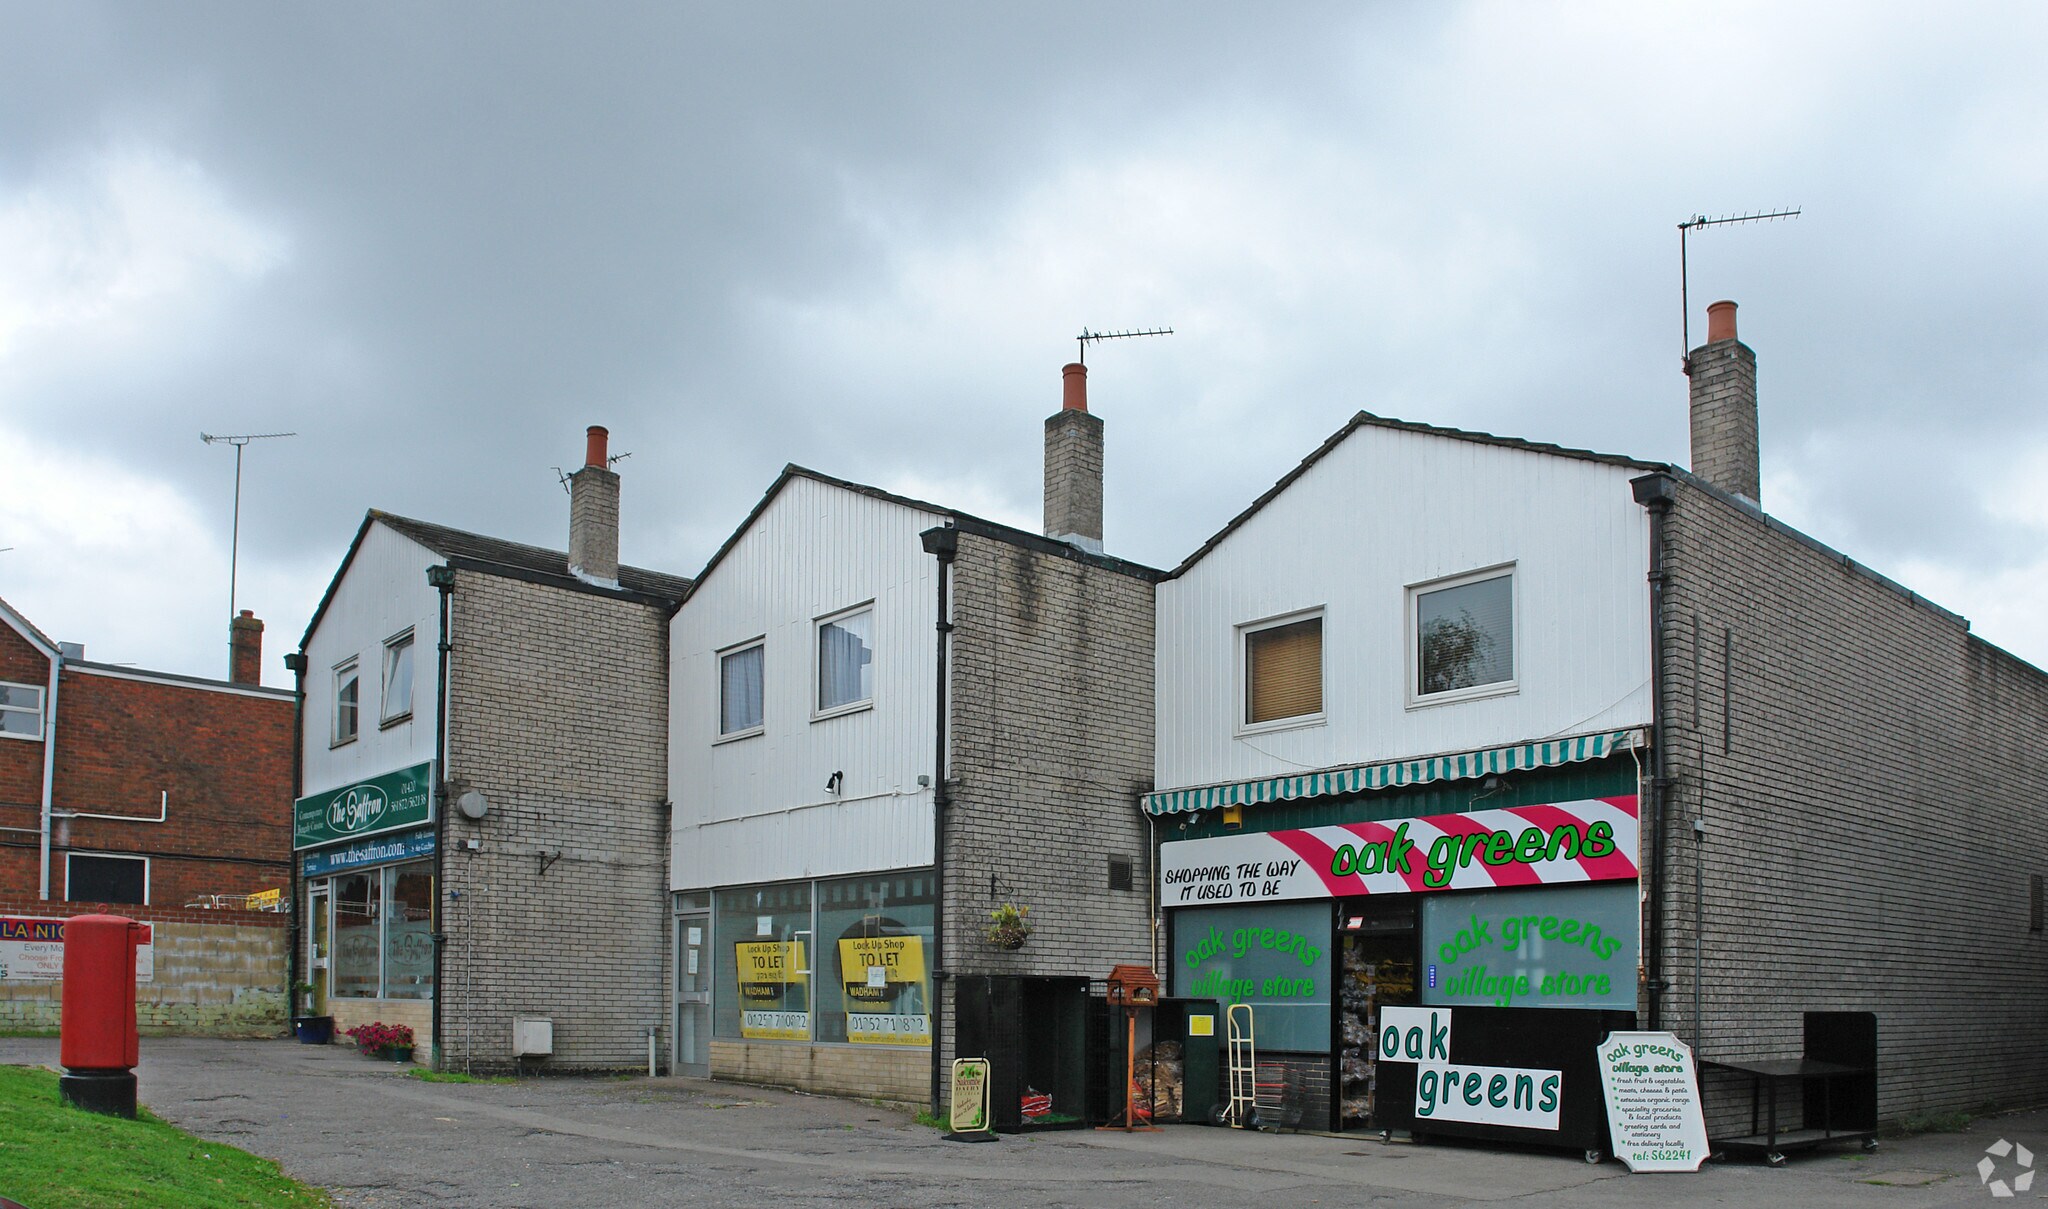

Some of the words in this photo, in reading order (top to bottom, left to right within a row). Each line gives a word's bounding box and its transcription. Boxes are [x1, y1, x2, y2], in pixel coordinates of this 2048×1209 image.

[332, 801, 345, 824] The
[346, 790, 382, 830] Saffron
[1330, 821, 1415, 877] oak
[1423, 820, 1616, 888] greens
[1165, 865, 1231, 885] SHOPPING
[1237, 862, 1263, 879] THE
[1267, 859, 1301, 877] WAY
[1180, 885, 1195, 901] IT
[1197, 883, 1233, 900] USED
[1239, 881, 1258, 898] TO
[1261, 880, 1281, 896] BE
[1438, 914, 1493, 964] oak
[1502, 915, 1622, 960] greens
[24, 944, 48, 952] Every
[762, 945, 772, 954] Up
[853, 941, 869, 950] Lock
[871, 941, 882, 951] Up
[884, 940, 905, 950] Shop
[1185, 926, 1227, 969] oak
[1232, 927, 1322, 967] greens
[37, 961, 59, 970] ONLY
[752, 956, 766, 969] TO
[768, 956, 785, 969] LET
[859, 953, 875, 967] TO
[880, 952, 899, 967] LET
[745, 986, 771, 996] WADHAM
[850, 987, 880, 997] WADHAM
[1191, 969, 1255, 1005] village
[1262, 975, 1315, 997] store
[1445, 965, 1530, 1007] village
[1540, 970, 1611, 995] store
[1382, 1011, 1448, 1060] oak
[1607, 1043, 1631, 1062] oak
[1633, 1044, 1684, 1062] greens
[1612, 1061, 1650, 1077] village
[1654, 1064, 1684, 1073] store
[1655, 1077, 1685, 1086] vegetables
[1418, 1070, 1559, 1116] greens
[1647, 1096, 1671, 1105] organic
[1672, 1097, 1690, 1105] range
[1621, 1105, 1650, 1114] speciality
[1652, 1106, 1682, 1115] groceries
[1653, 1114, 1682, 1122] products
[1624, 1123, 1648, 1131] greeting
[1631, 1131, 1661, 1139] stationery
[1641, 1140, 1664, 1148] delivery
[1665, 1140, 1684, 1148] locally
[1632, 1150, 1649, 1161] tel:
[1651, 1150, 1691, 1161] 562241
